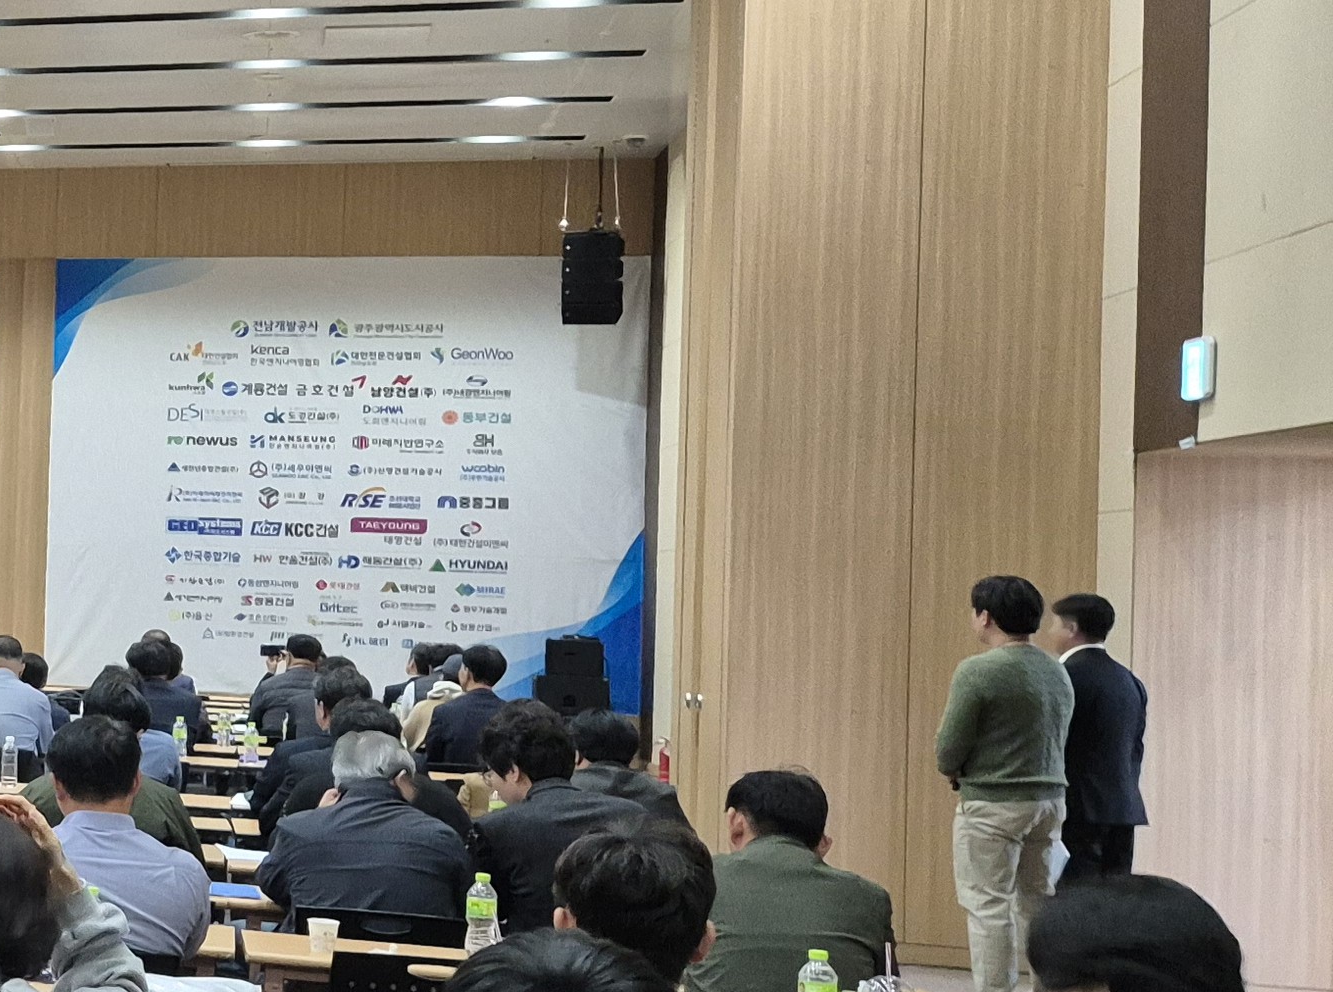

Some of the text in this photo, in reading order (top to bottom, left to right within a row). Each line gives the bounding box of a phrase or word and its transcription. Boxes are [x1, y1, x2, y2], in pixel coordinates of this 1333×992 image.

[253, 319, 319, 333] 전남개발공사
[354, 323, 444, 334] 광주광역시도시공사
[169, 352, 189, 362] CAK
[351, 351, 421, 361] 대한전문건설협회
[451, 348, 513, 360] GeonWoo
[251, 358, 319, 367] 한국엔지니어링협회
[241, 383, 288, 396] 계룡건설
[462, 412, 511, 424] 동부건설
[269, 434, 336, 442] MANSEUNG
[371, 438, 445, 448] 미래지반연구소
[253, 521, 280, 534] KCC
[285, 523, 339, 538] KCC건설
[359, 520, 420, 530] TAEYOUNG
[183, 550, 241, 562] 한국종합기술
[449, 558, 509, 571] HYUNDAI
